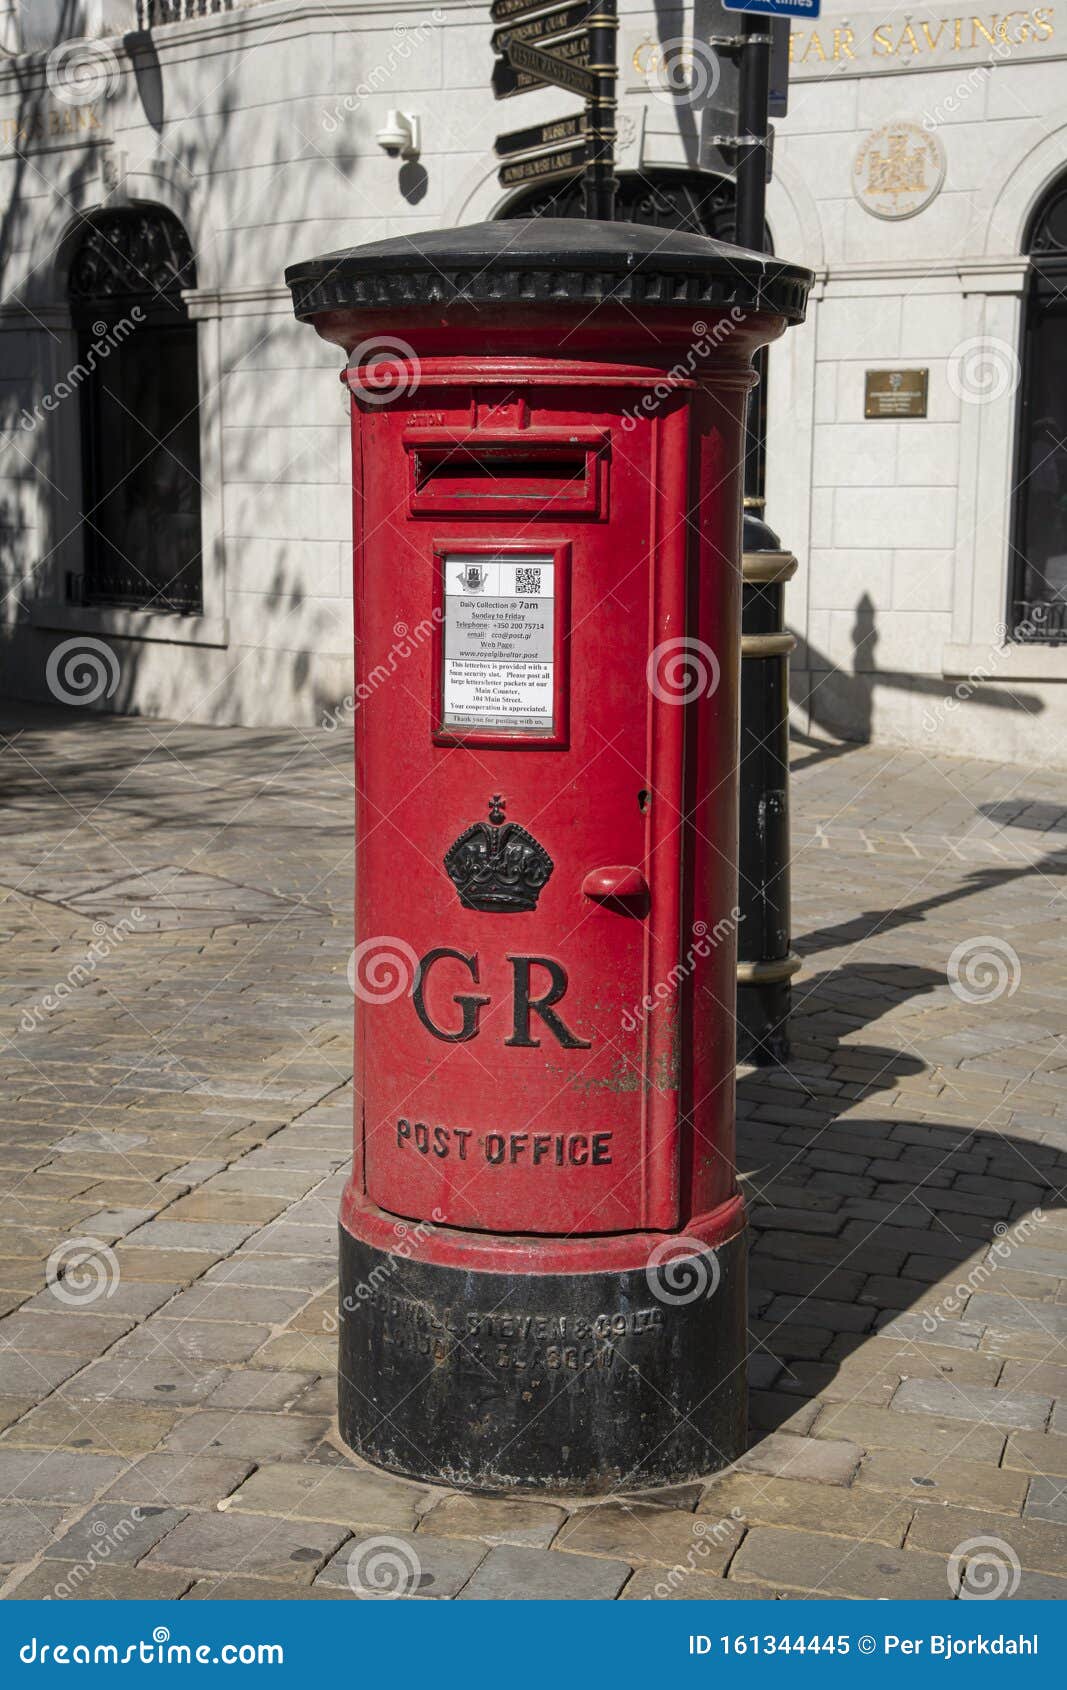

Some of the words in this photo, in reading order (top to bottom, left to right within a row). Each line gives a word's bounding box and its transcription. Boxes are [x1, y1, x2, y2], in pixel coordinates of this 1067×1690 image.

[872, 8, 1054, 58] SAVINGS
[460, 601, 475, 609] Daily
[476, 601, 508, 609] Collection
[519, 600, 539, 610] 7am
[472, 612, 495, 620] Sunday
[504, 613, 526, 621] Friday
[480, 641, 496, 649] Web
[499, 663, 527, 671] provided
[464, 671, 487, 679] security
[527, 672, 540, 680] post
[450, 678, 465, 686] large
[503, 680, 527, 688] packets
[450, 702, 464, 710] Your
[465, 704, 501, 712] cooperation
[495, 717, 518, 725] posting
[412, 946, 592, 1049] GR
[396, 1118, 473, 1161] POST
[484, 1129, 614, 1167] OFFICE
[466, 1312, 568, 1340] STEVEN
